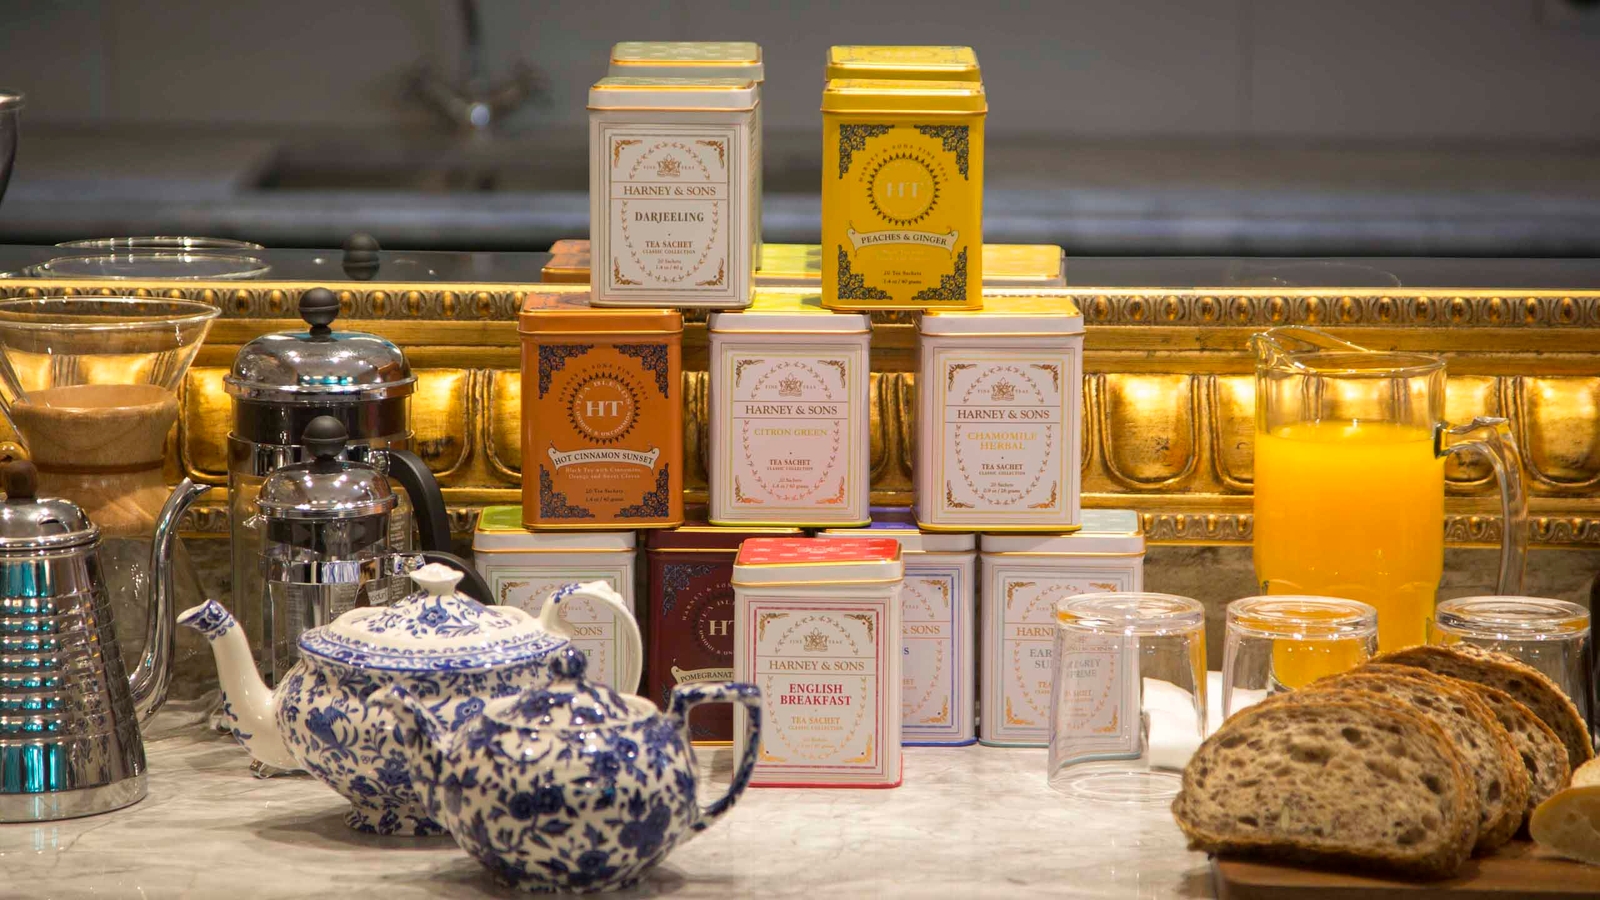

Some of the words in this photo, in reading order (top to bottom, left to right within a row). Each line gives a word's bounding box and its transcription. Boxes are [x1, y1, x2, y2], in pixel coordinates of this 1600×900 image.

[624, 186, 672, 196] HARNEY
[674, 186, 684, 196] &
[686, 186, 716, 196] SONS
[635, 212, 705, 223] DARJEELING
[861, 233, 901, 244] PEACHES
[913, 234, 947, 246] GINGER
[558, 373, 578, 402] HARNEY
[576, 387, 591, 406] TEA
[593, 380, 631, 405] BLENDS
[586, 400, 624, 416] HT
[745, 405, 793, 415] HARNEY
[795, 406, 806, 415] &
[808, 405, 838, 415] SONS
[958, 410, 1005, 419] HARNEY
[1008, 410, 1017, 419] &
[1020, 410, 1050, 419] SONS
[600, 412, 632, 436] UNCOMMON
[967, 432, 1038, 441] CHAMOMILE
[980, 442, 1026, 450] HERBAL
[554, 456, 572, 466] HOT
[574, 452, 620, 461] CINNAMON
[622, 453, 654, 465] SUNSET
[682, 592, 702, 621] HARNEY
[574, 627, 603, 635] SONS
[910, 625, 940, 635] SONS
[1017, 627, 1054, 636] HARN
[1030, 648, 1052, 657] EAR
[769, 660, 818, 670] HARNEY
[821, 661, 831, 670] &
[834, 661, 865, 671] SONS
[680, 671, 734, 683] POMEGRANAT
[789, 683, 843, 694] ENGLISH
[780, 695, 852, 706] BREAKFAST
